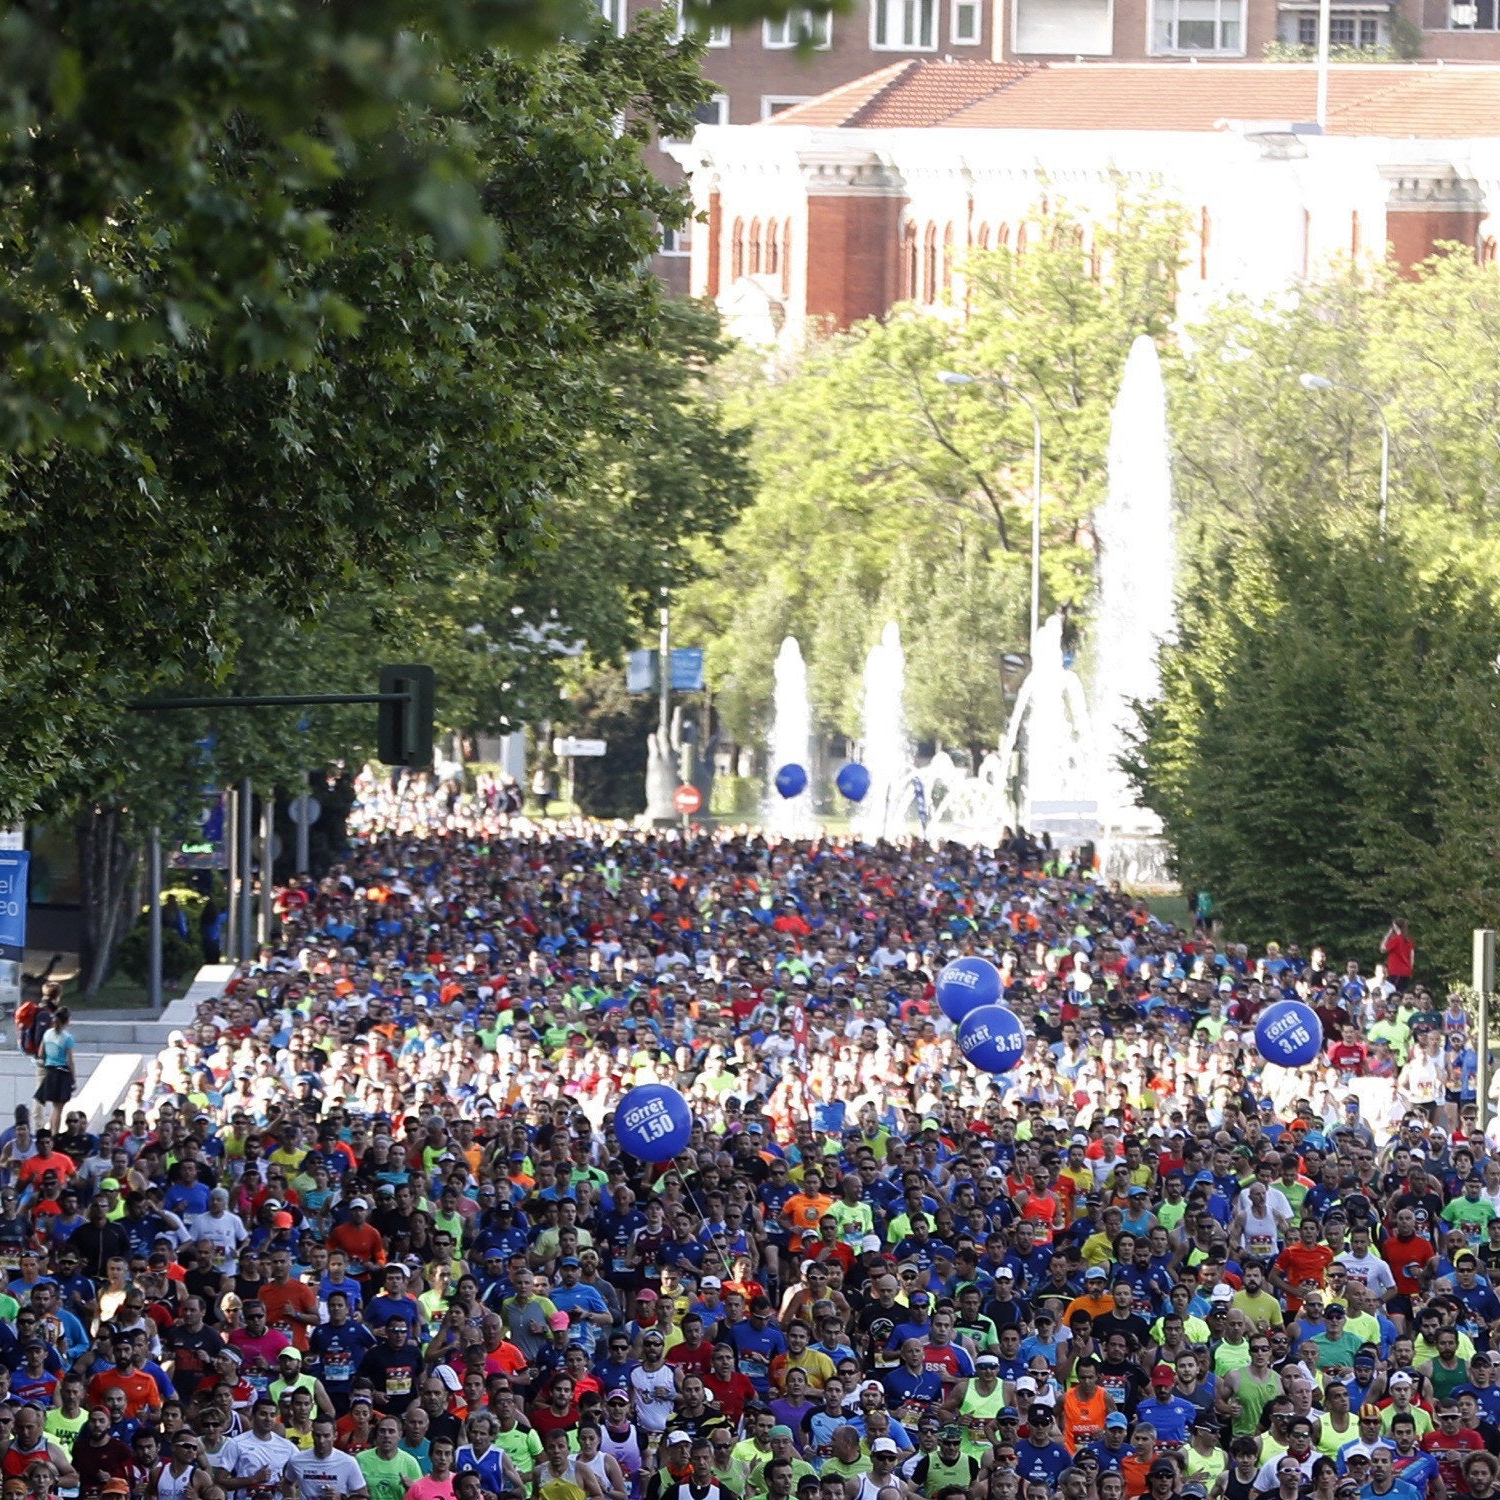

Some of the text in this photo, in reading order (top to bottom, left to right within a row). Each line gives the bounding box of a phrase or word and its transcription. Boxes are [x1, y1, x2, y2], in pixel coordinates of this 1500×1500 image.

[995, 1033, 1021, 1053] 3.15
[1278, 1026, 1311, 1055] 3.15
[625, 1100, 665, 1127] correr
[638, 1114, 675, 1143] 1.50
[303, 1473, 338, 1481] IRONMAN
